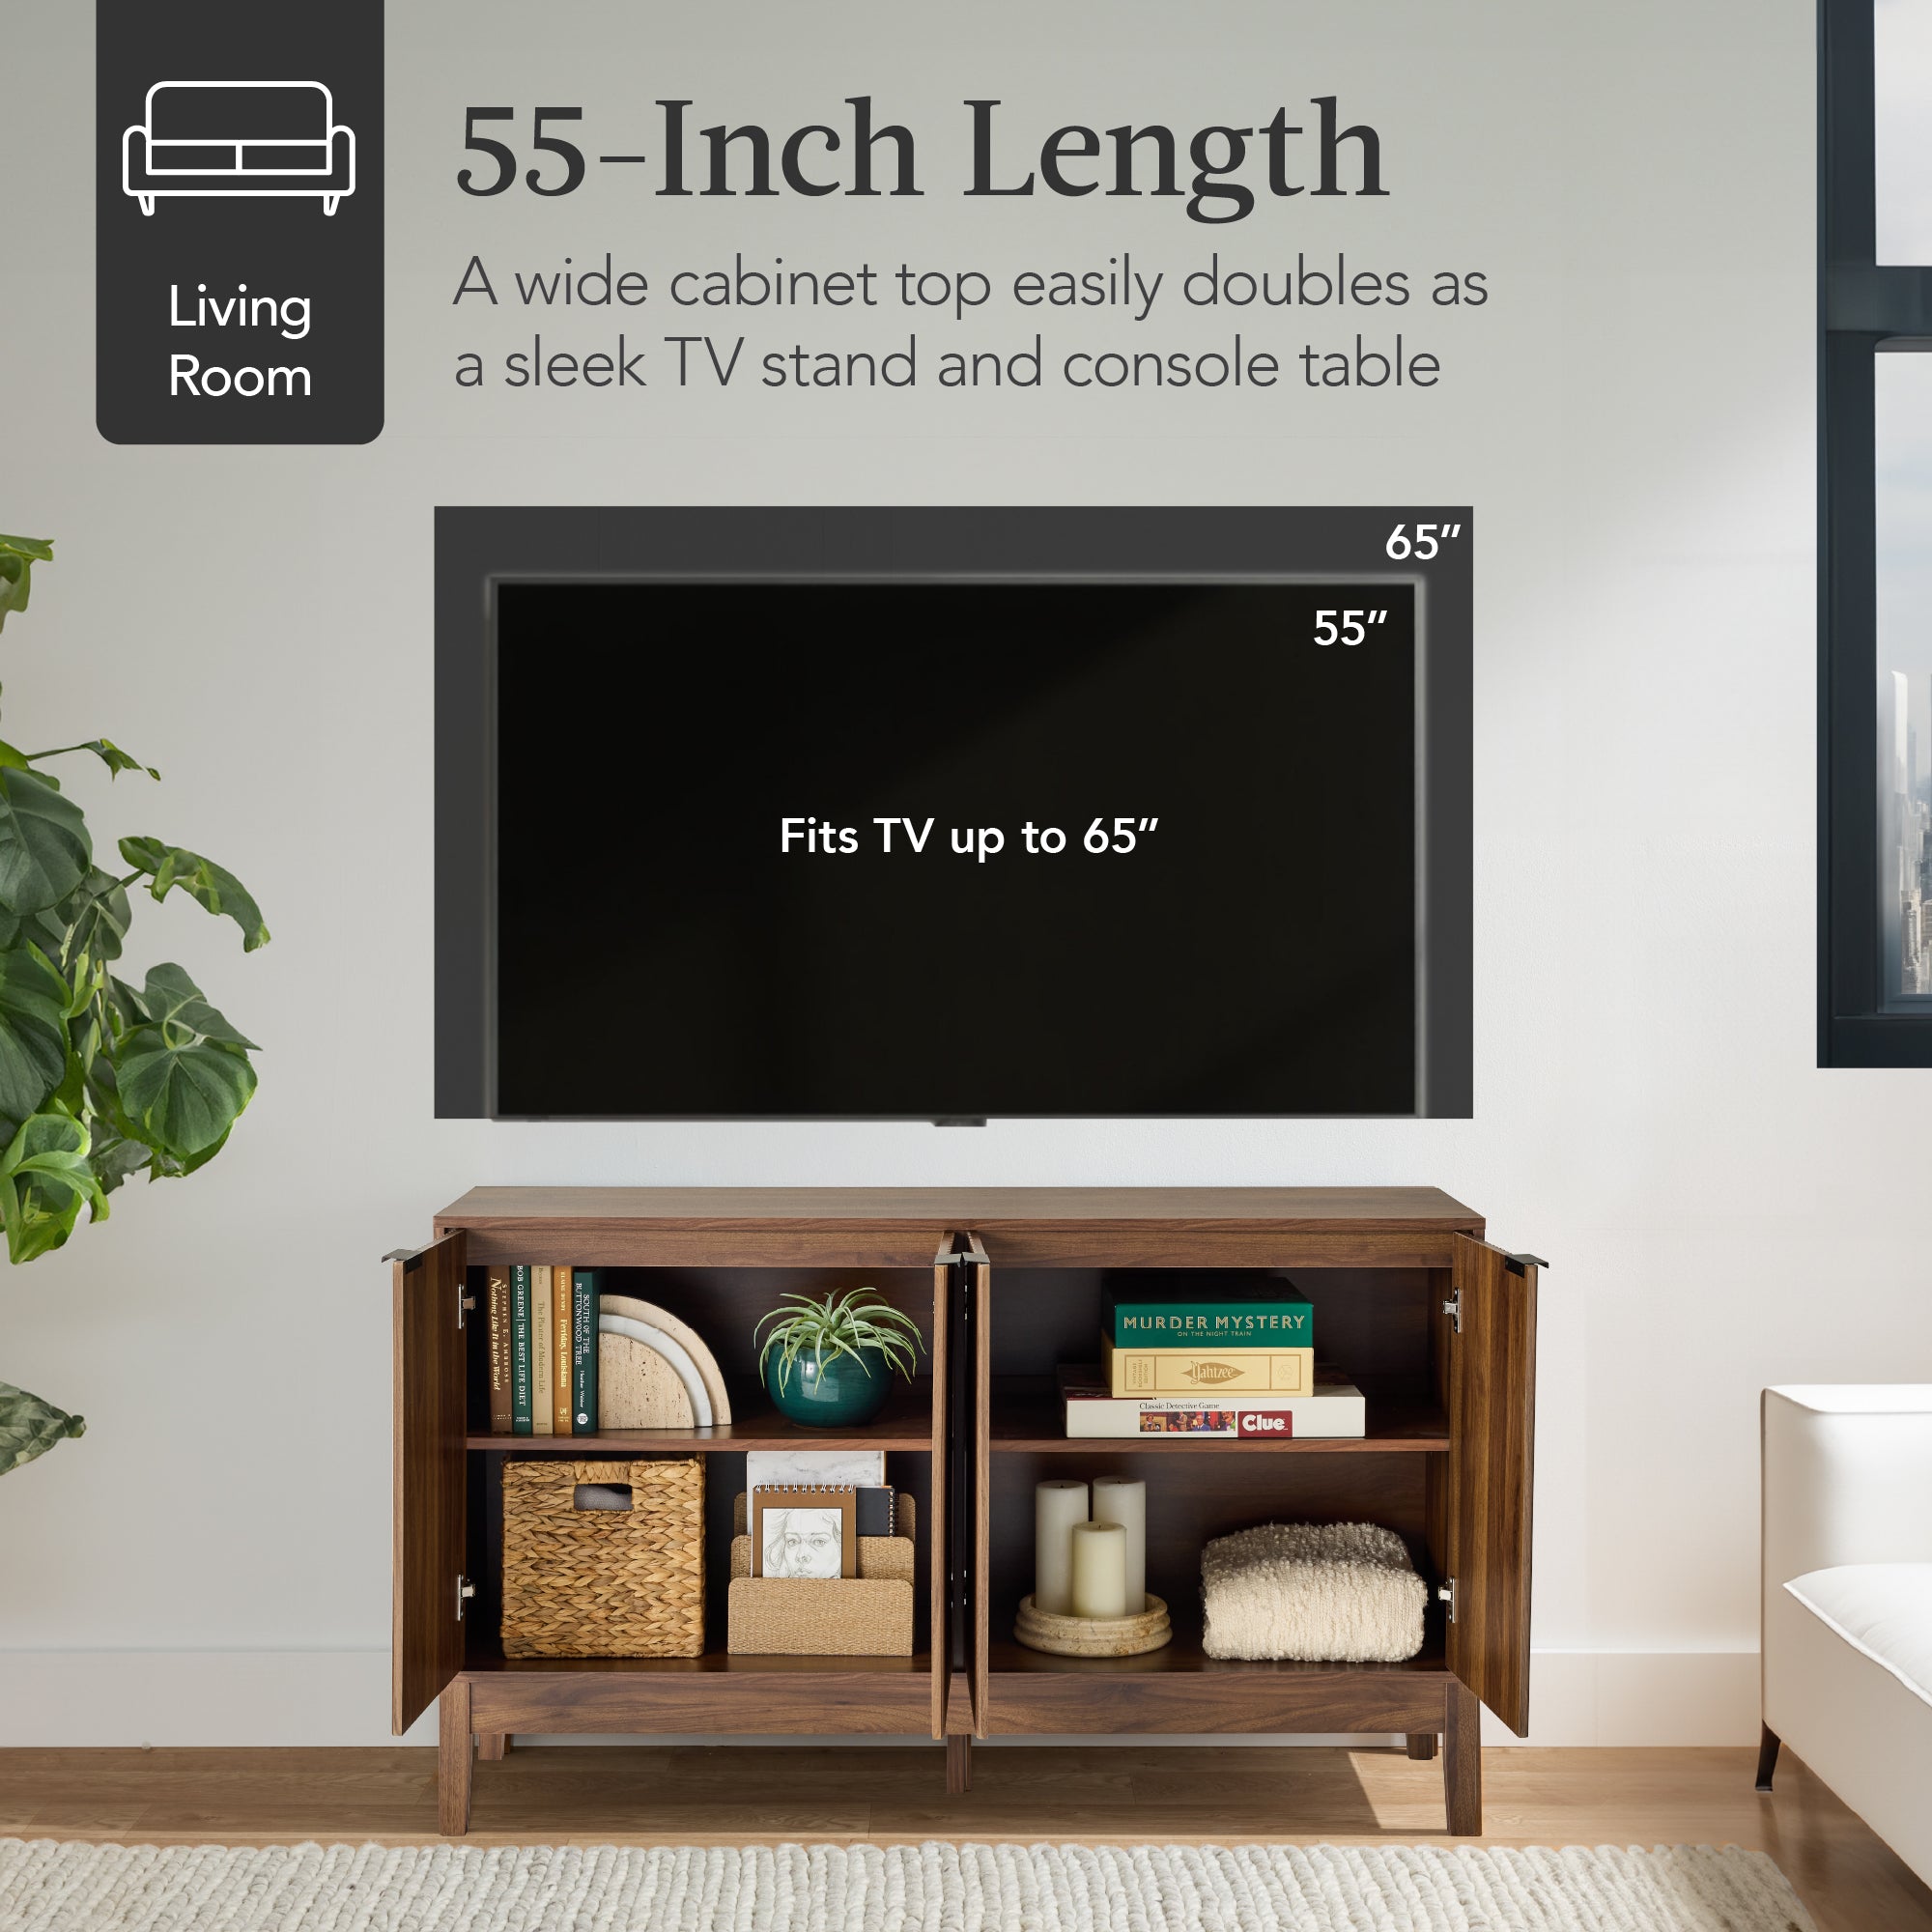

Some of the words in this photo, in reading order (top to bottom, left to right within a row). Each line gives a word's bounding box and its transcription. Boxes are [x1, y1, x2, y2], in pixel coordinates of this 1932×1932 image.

[490, 1277, 502, 1315] Nothing
[575, 1283, 583, 1343] BUTTONWOOD
[491, 1315, 500, 1332] Like
[583, 1324, 590, 1335] OF
[1123, 1315, 1208, 1329] MURDER
[1215, 1315, 1305, 1329] MYSTERY
[492, 1341, 500, 1350] in
[492, 1350, 500, 1364] the
[493, 1365, 501, 1391] World
[1189, 1360, 1235, 1385] Yahtzee
[1139, 1402, 1165, 1410] Classic
[1166, 1402, 1198, 1410] Detective
[1198, 1402, 1220, 1410] Game
[1241, 1413, 1286, 1433] Clue
